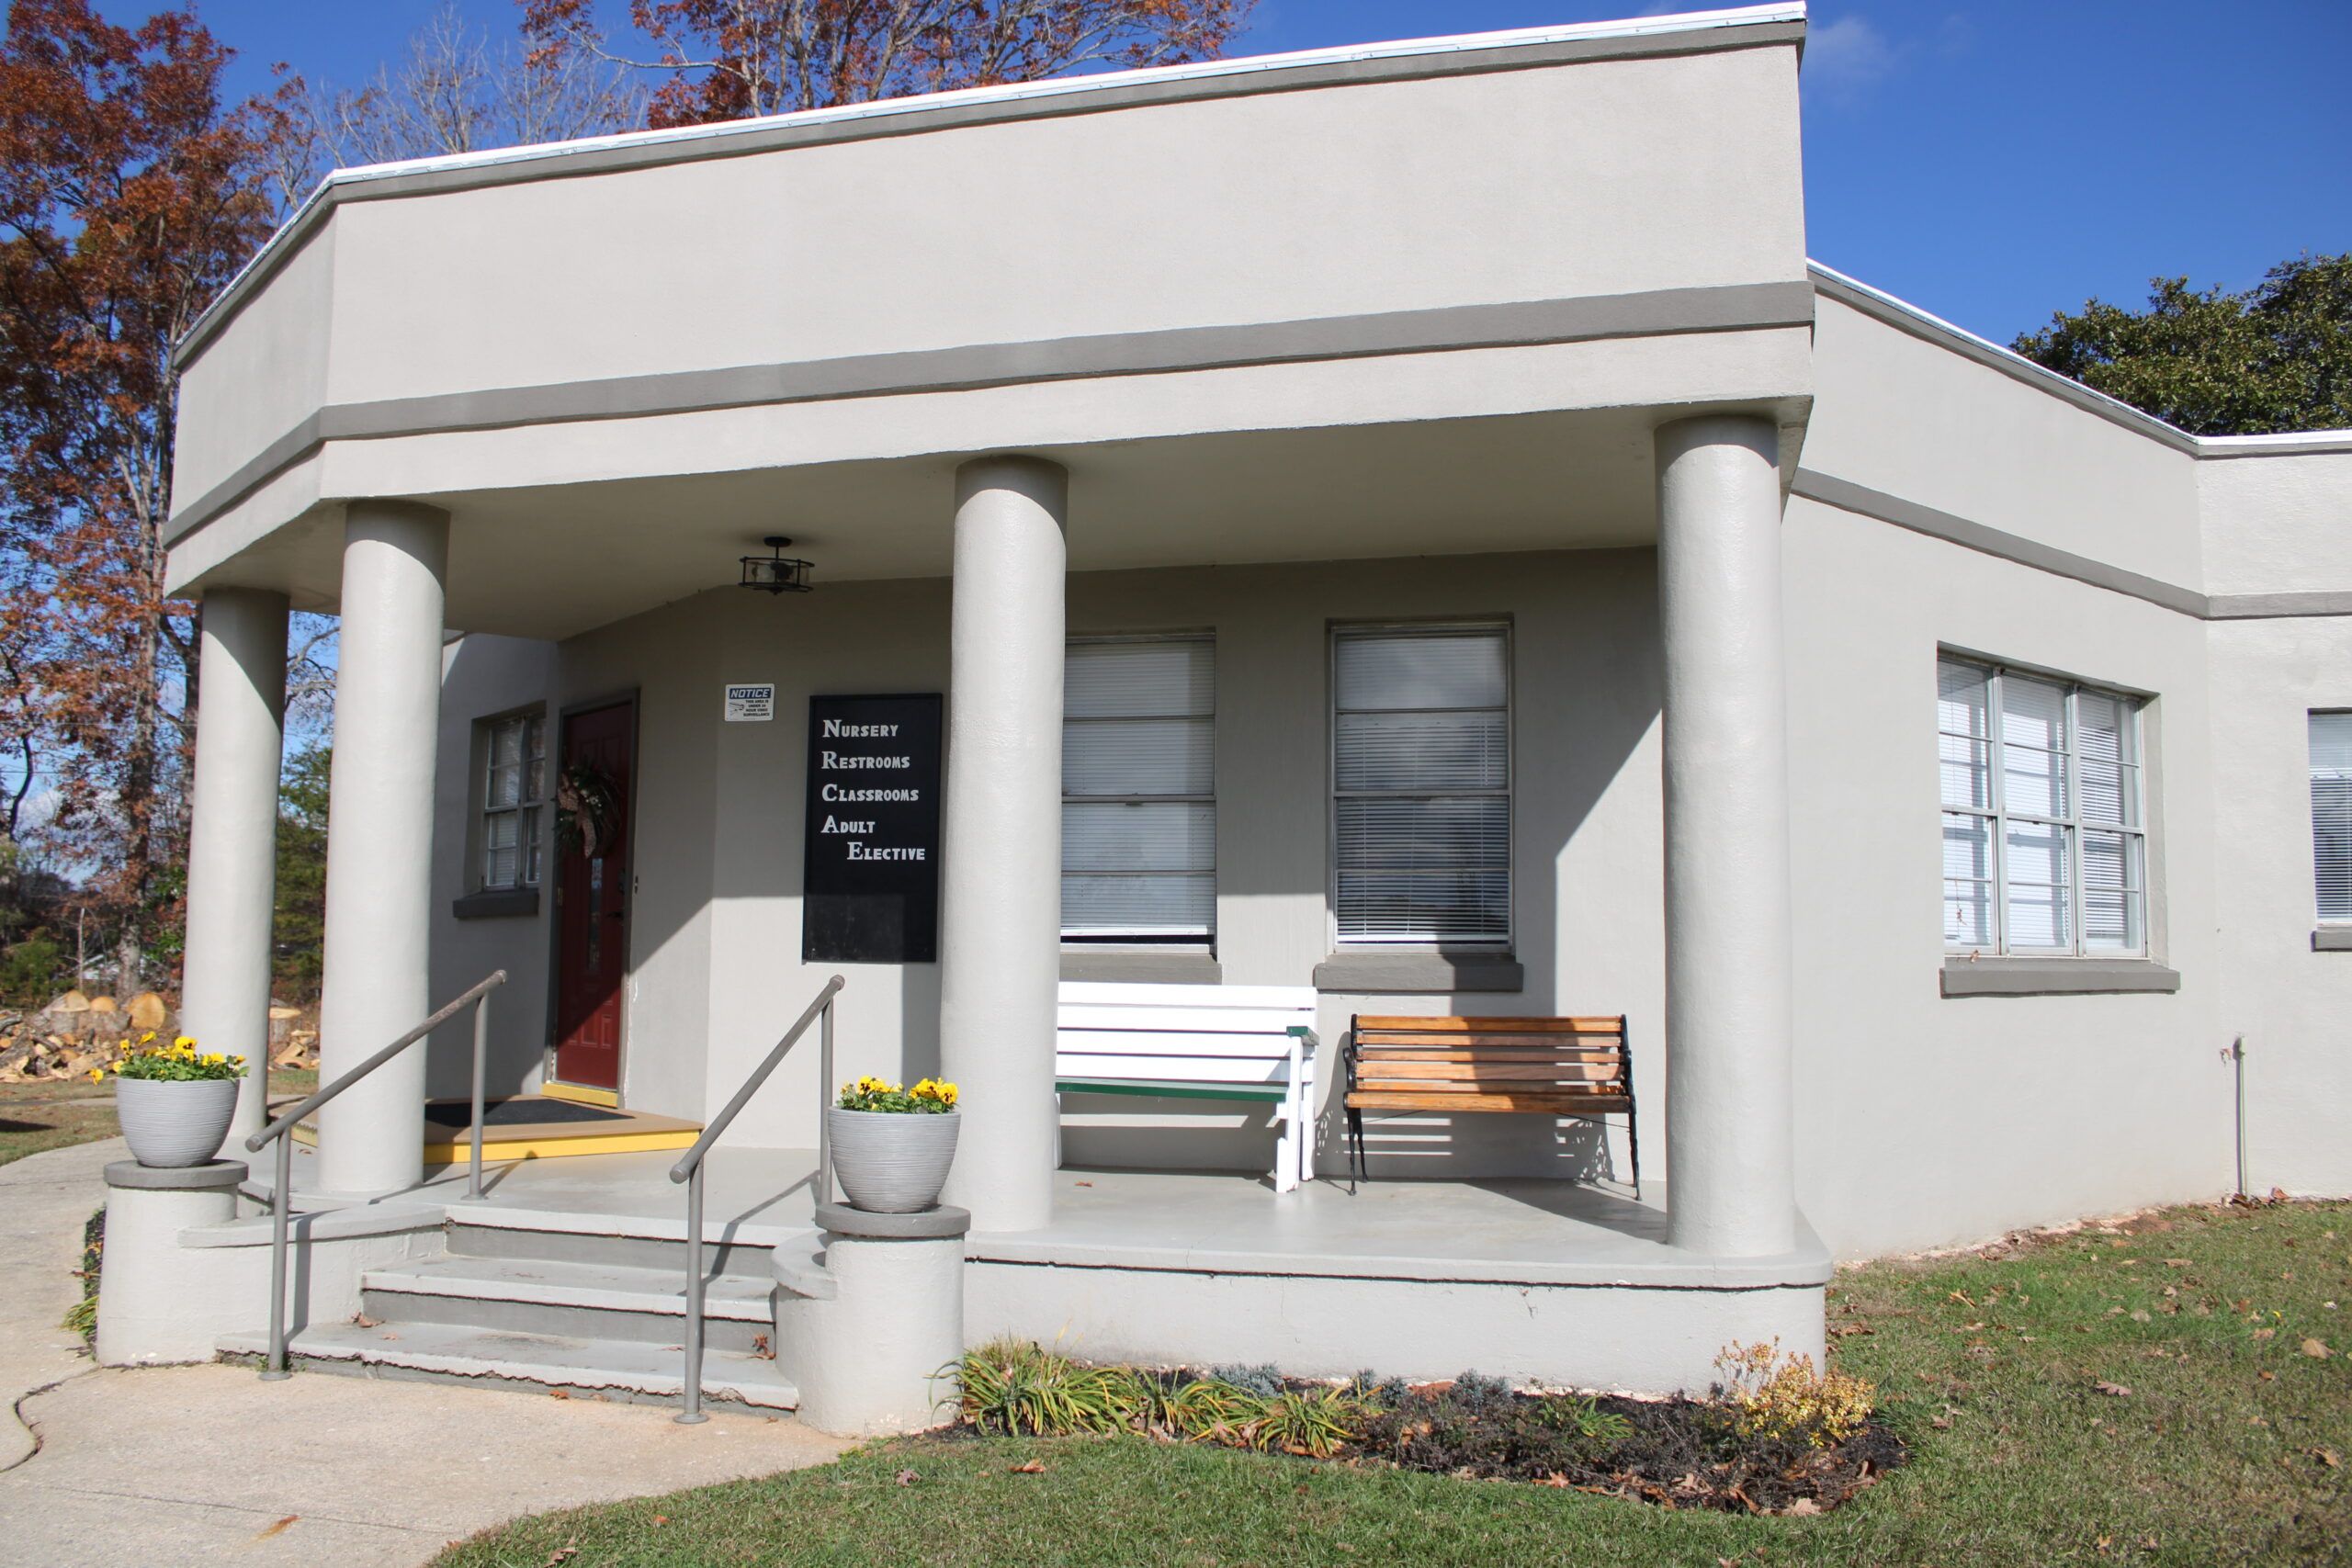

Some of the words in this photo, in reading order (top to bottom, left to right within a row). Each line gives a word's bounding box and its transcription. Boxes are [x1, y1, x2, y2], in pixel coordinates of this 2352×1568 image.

[730, 689, 770, 698] NOTICE
[822, 719, 899, 738] NURSERY
[821, 750, 910, 769] RESTROOMS
[821, 784, 919, 802] CLASSROOMS
[820, 815, 876, 834] ADULT
[846, 841, 925, 861] ELECTIVE
